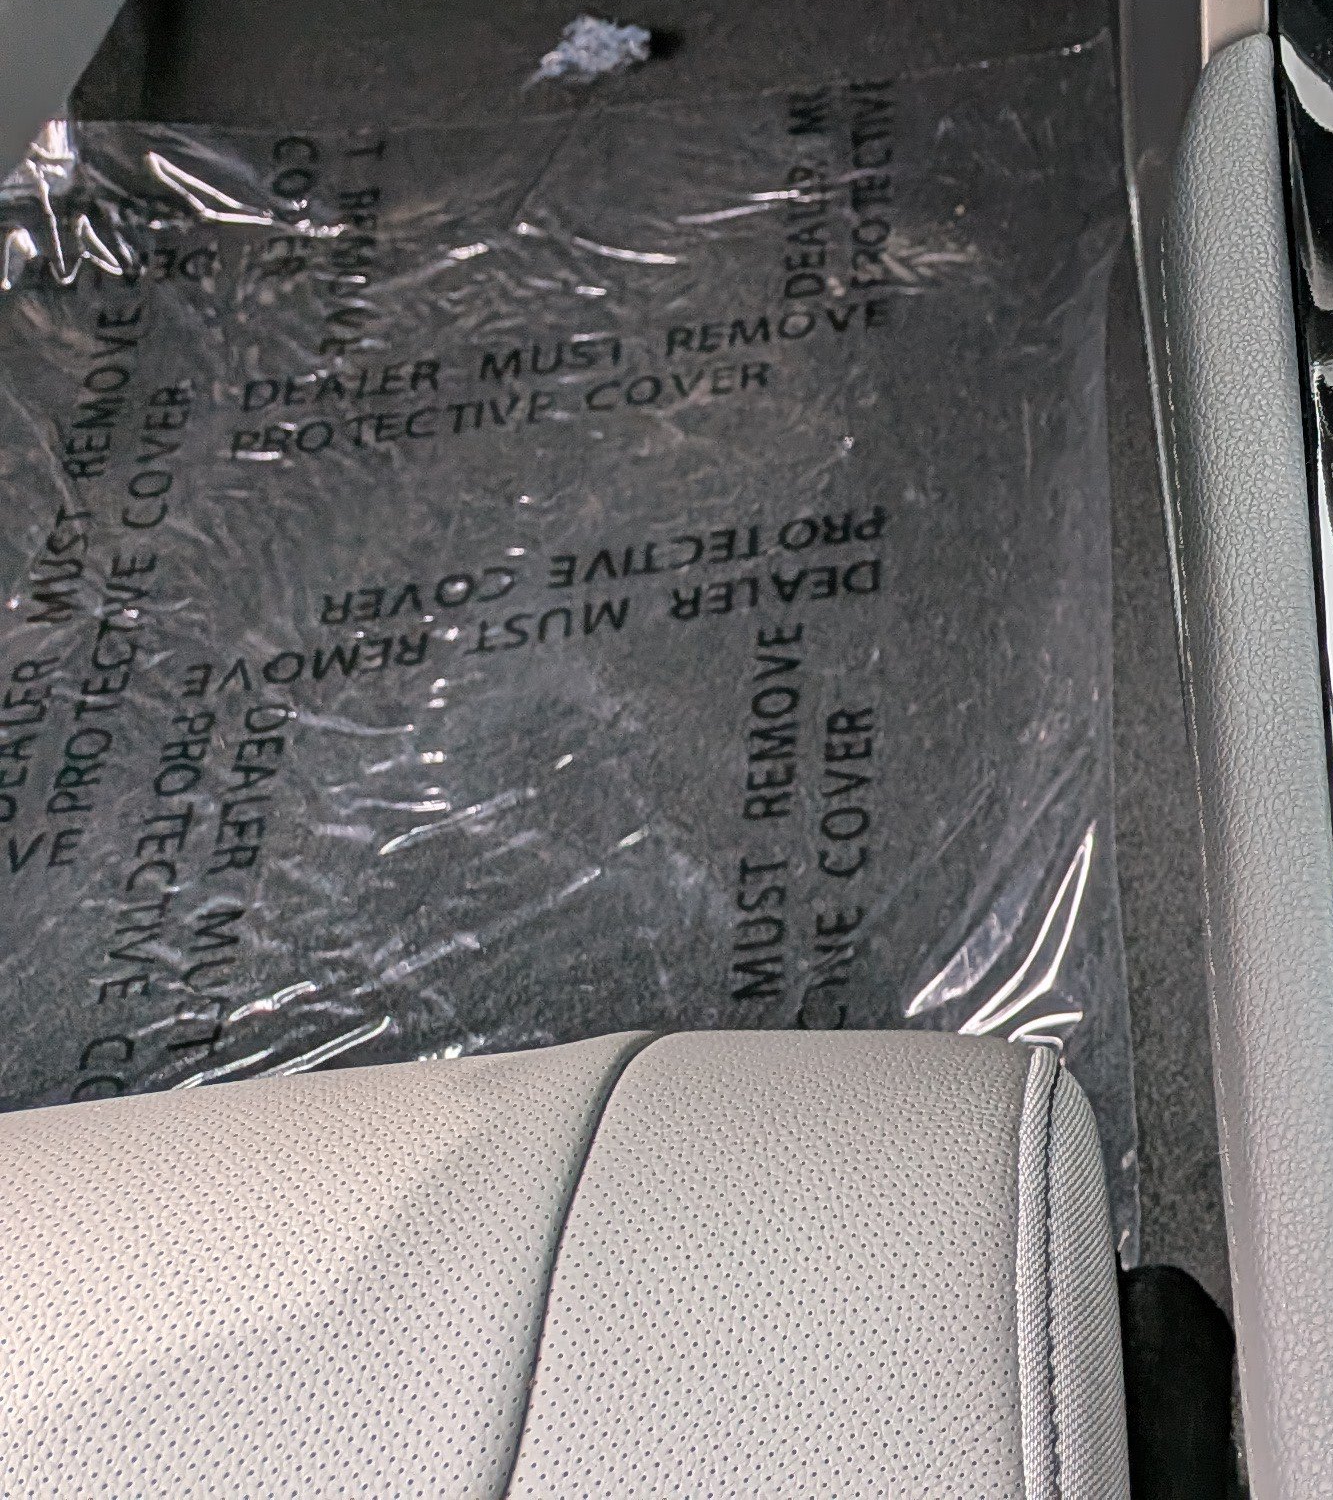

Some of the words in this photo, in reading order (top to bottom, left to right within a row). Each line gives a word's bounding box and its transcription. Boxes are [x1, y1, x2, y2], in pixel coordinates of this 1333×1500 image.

[64, 306, 142, 481] REMOVE
[582, 360, 772, 412] COVER
[121, 384, 193, 529] COVER
[319, 563, 516, 627] COVER
[549, 503, 888, 590] PROTECTIVE
[669, 558, 884, 621] DEALER
[184, 632, 429, 699] REMOVE
[465, 599, 631, 658] MUST
[743, 621, 803, 822] REMOVE
[213, 699, 294, 875] DEALER
[818, 705, 876, 880] COVER
[732, 856, 790, 1002] MUST
